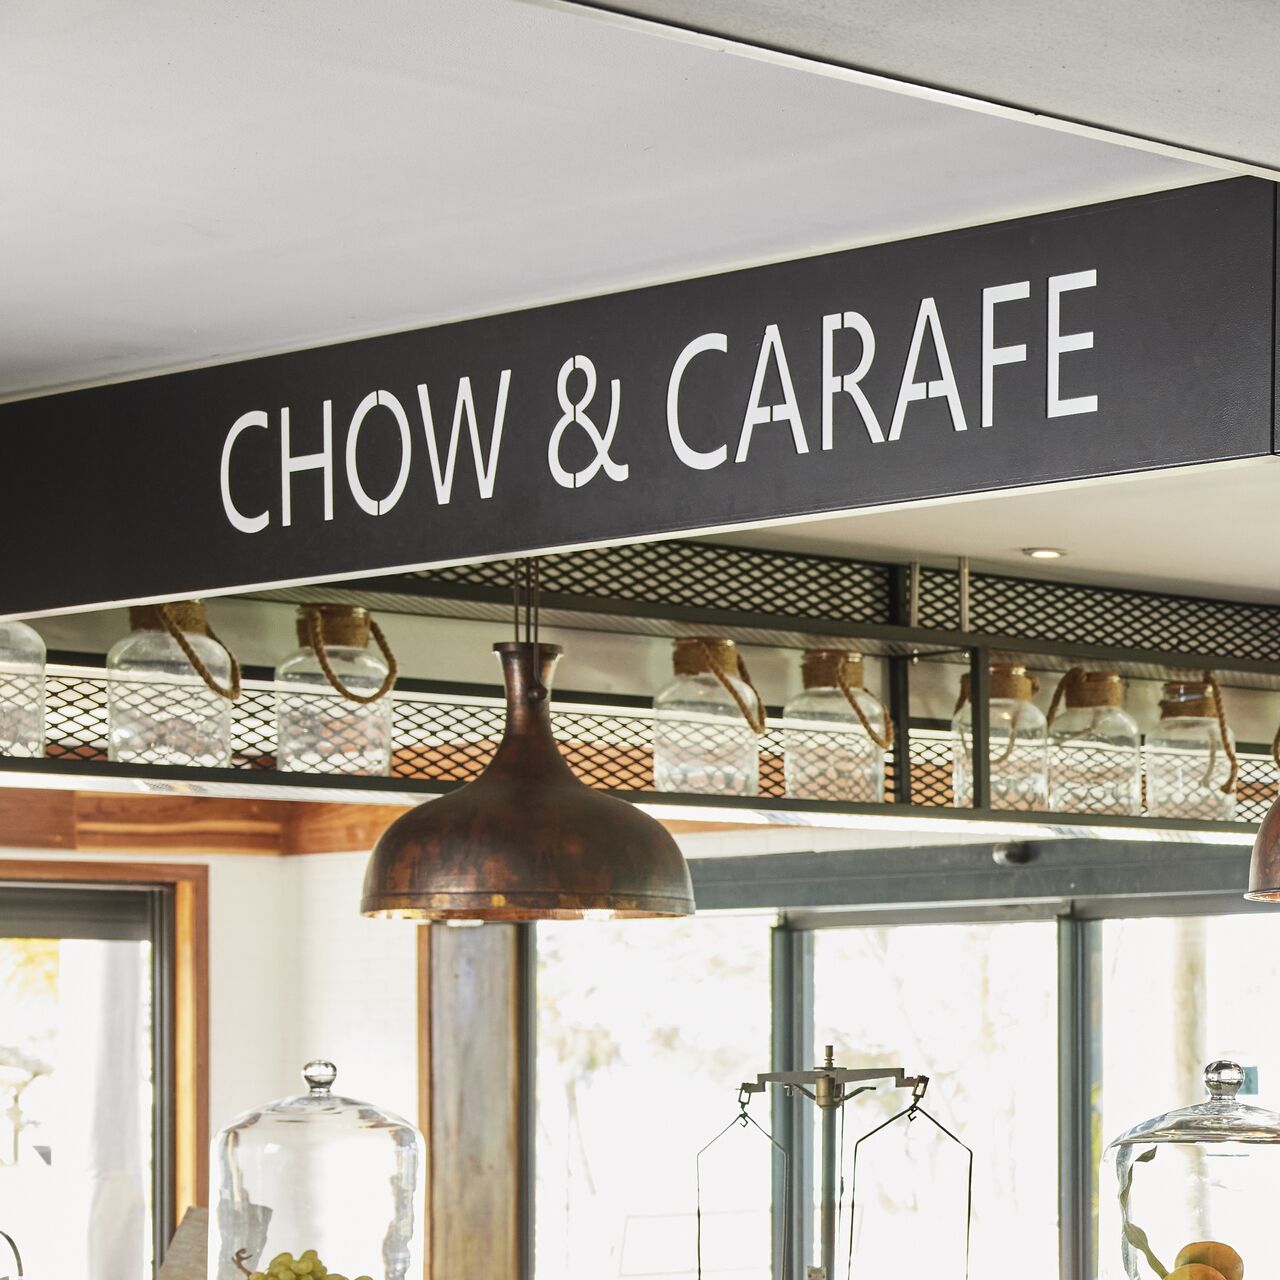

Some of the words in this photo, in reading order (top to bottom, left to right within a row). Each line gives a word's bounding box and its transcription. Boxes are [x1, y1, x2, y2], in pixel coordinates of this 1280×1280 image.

[220, 369, 512, 534] CHOW
[547, 354, 629, 489] &
[666, 268, 1099, 471] CARAFE
